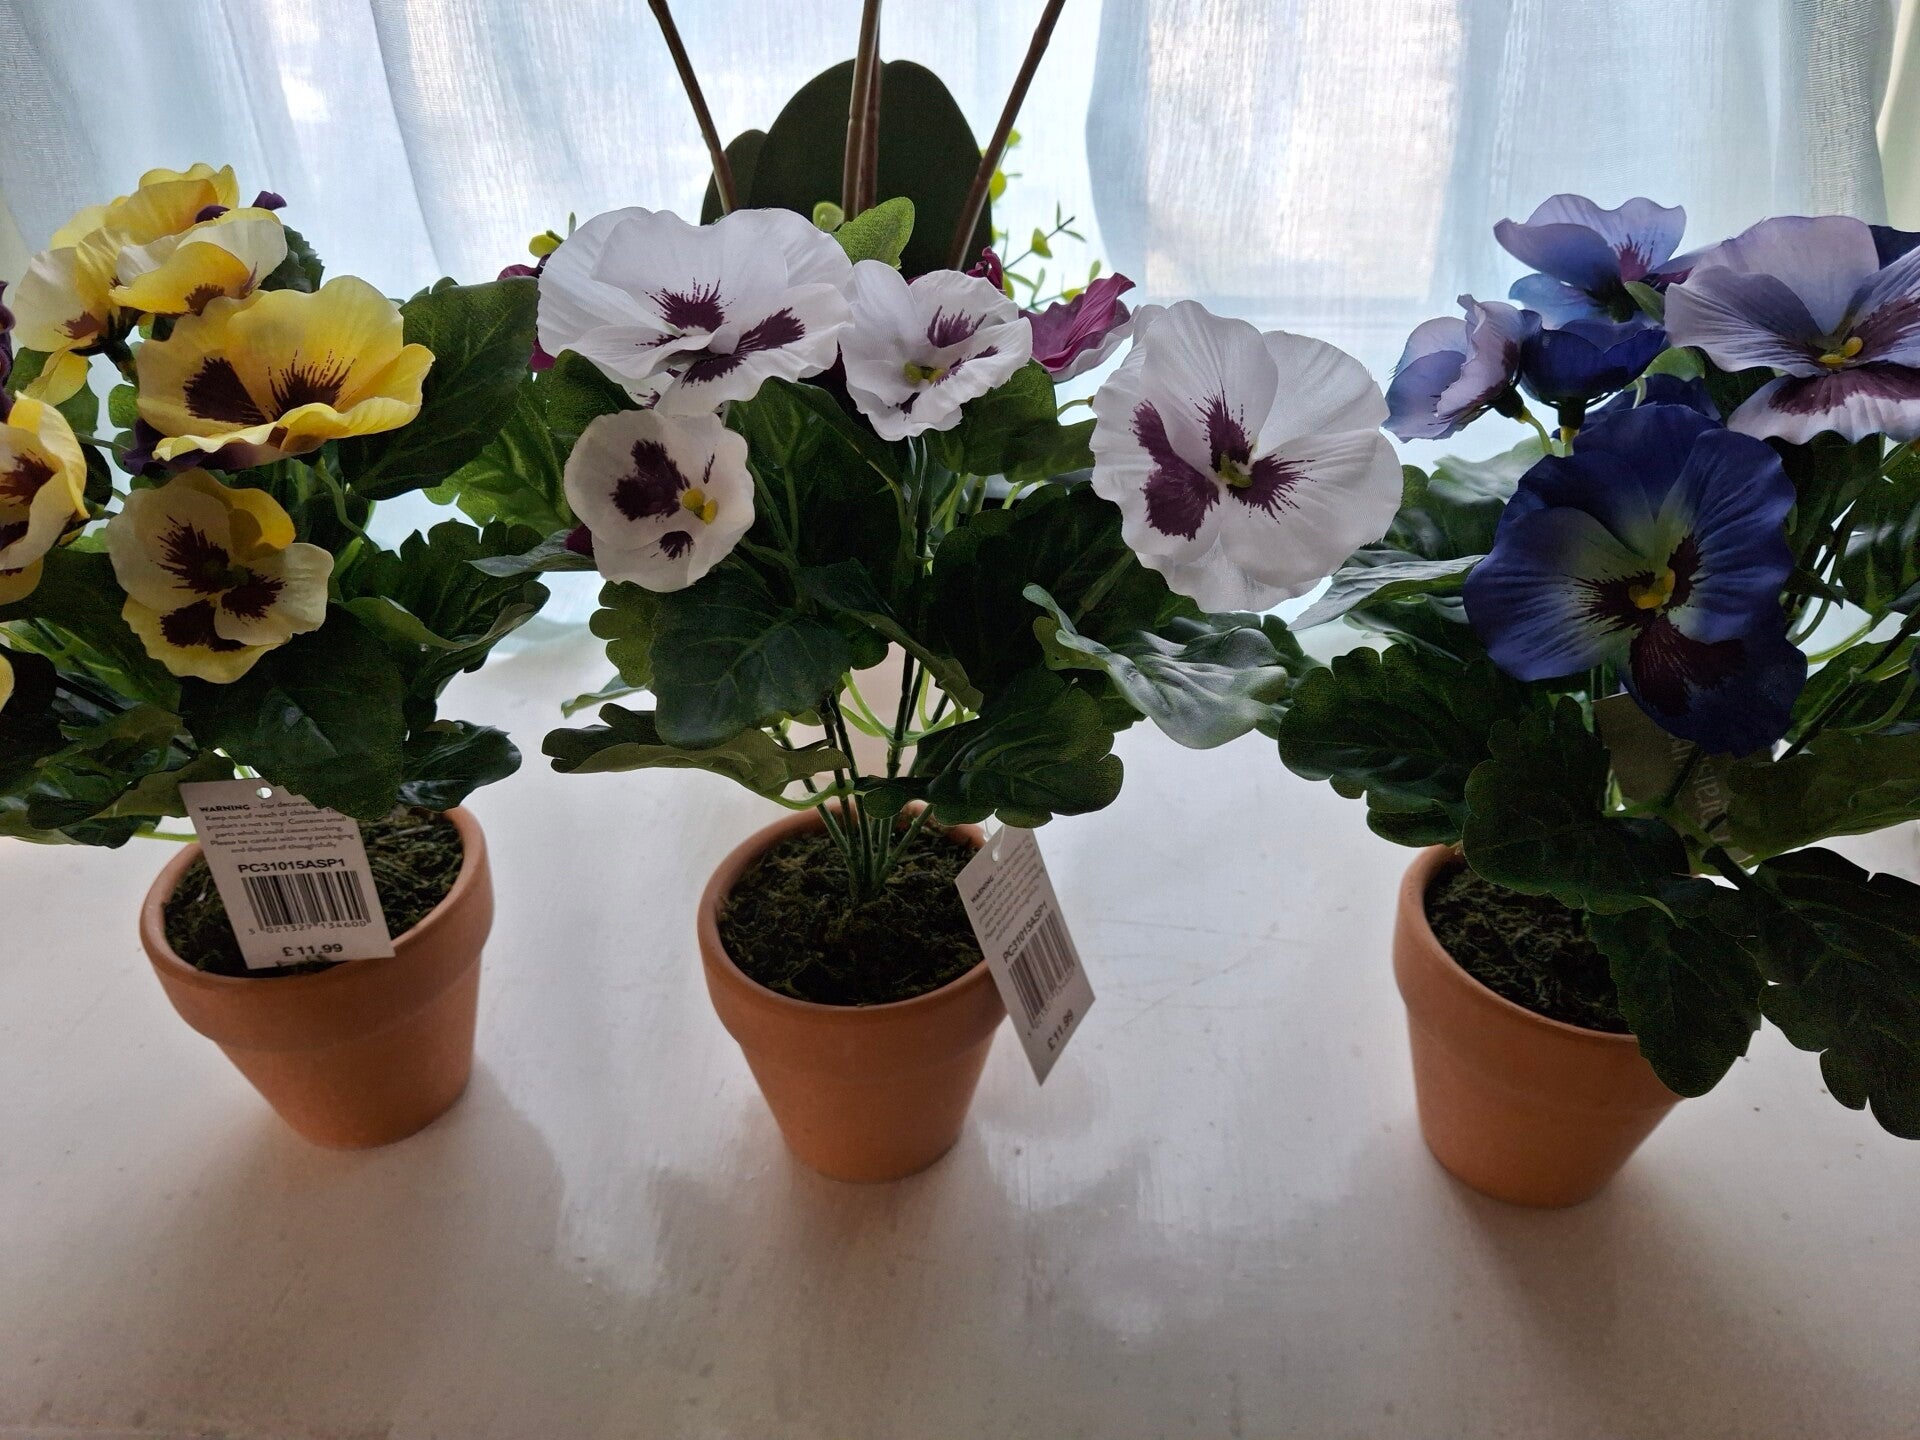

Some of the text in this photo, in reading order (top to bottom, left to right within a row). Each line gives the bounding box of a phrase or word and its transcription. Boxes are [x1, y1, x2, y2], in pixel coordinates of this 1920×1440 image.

[198, 804, 250, 812] WARNING
[206, 823, 238, 832] product
[326, 815, 347, 823] small
[249, 836, 278, 844] careful
[314, 833, 355, 841] packaging
[237, 858, 346, 873] PC31015ASP1
[970, 874, 994, 904] WARNING
[248, 920, 367, 936] 5 021327 134600
[1002, 899, 1048, 964] PC31015ASP1
[1047, 1008, 1074, 1051] £11.99
